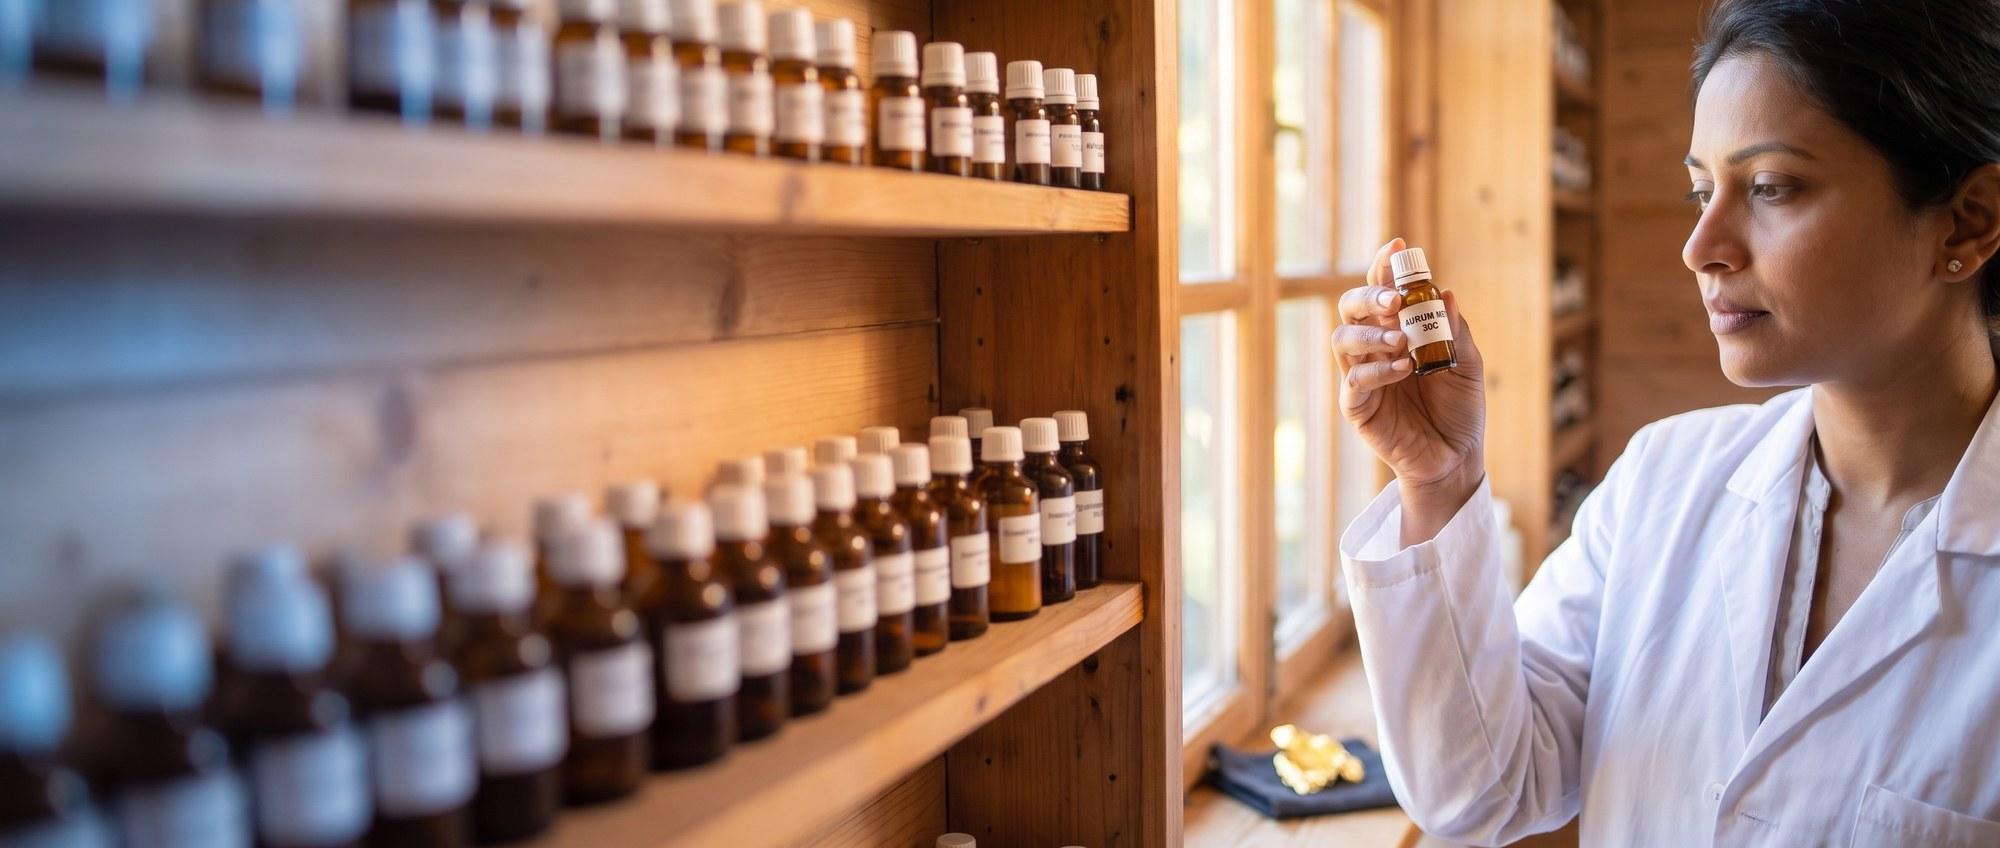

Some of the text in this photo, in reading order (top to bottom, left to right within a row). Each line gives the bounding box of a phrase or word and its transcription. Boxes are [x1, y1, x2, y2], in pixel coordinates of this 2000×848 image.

[1405, 310, 1447, 327] AURUM ME
[1422, 321, 1439, 332] 30C
